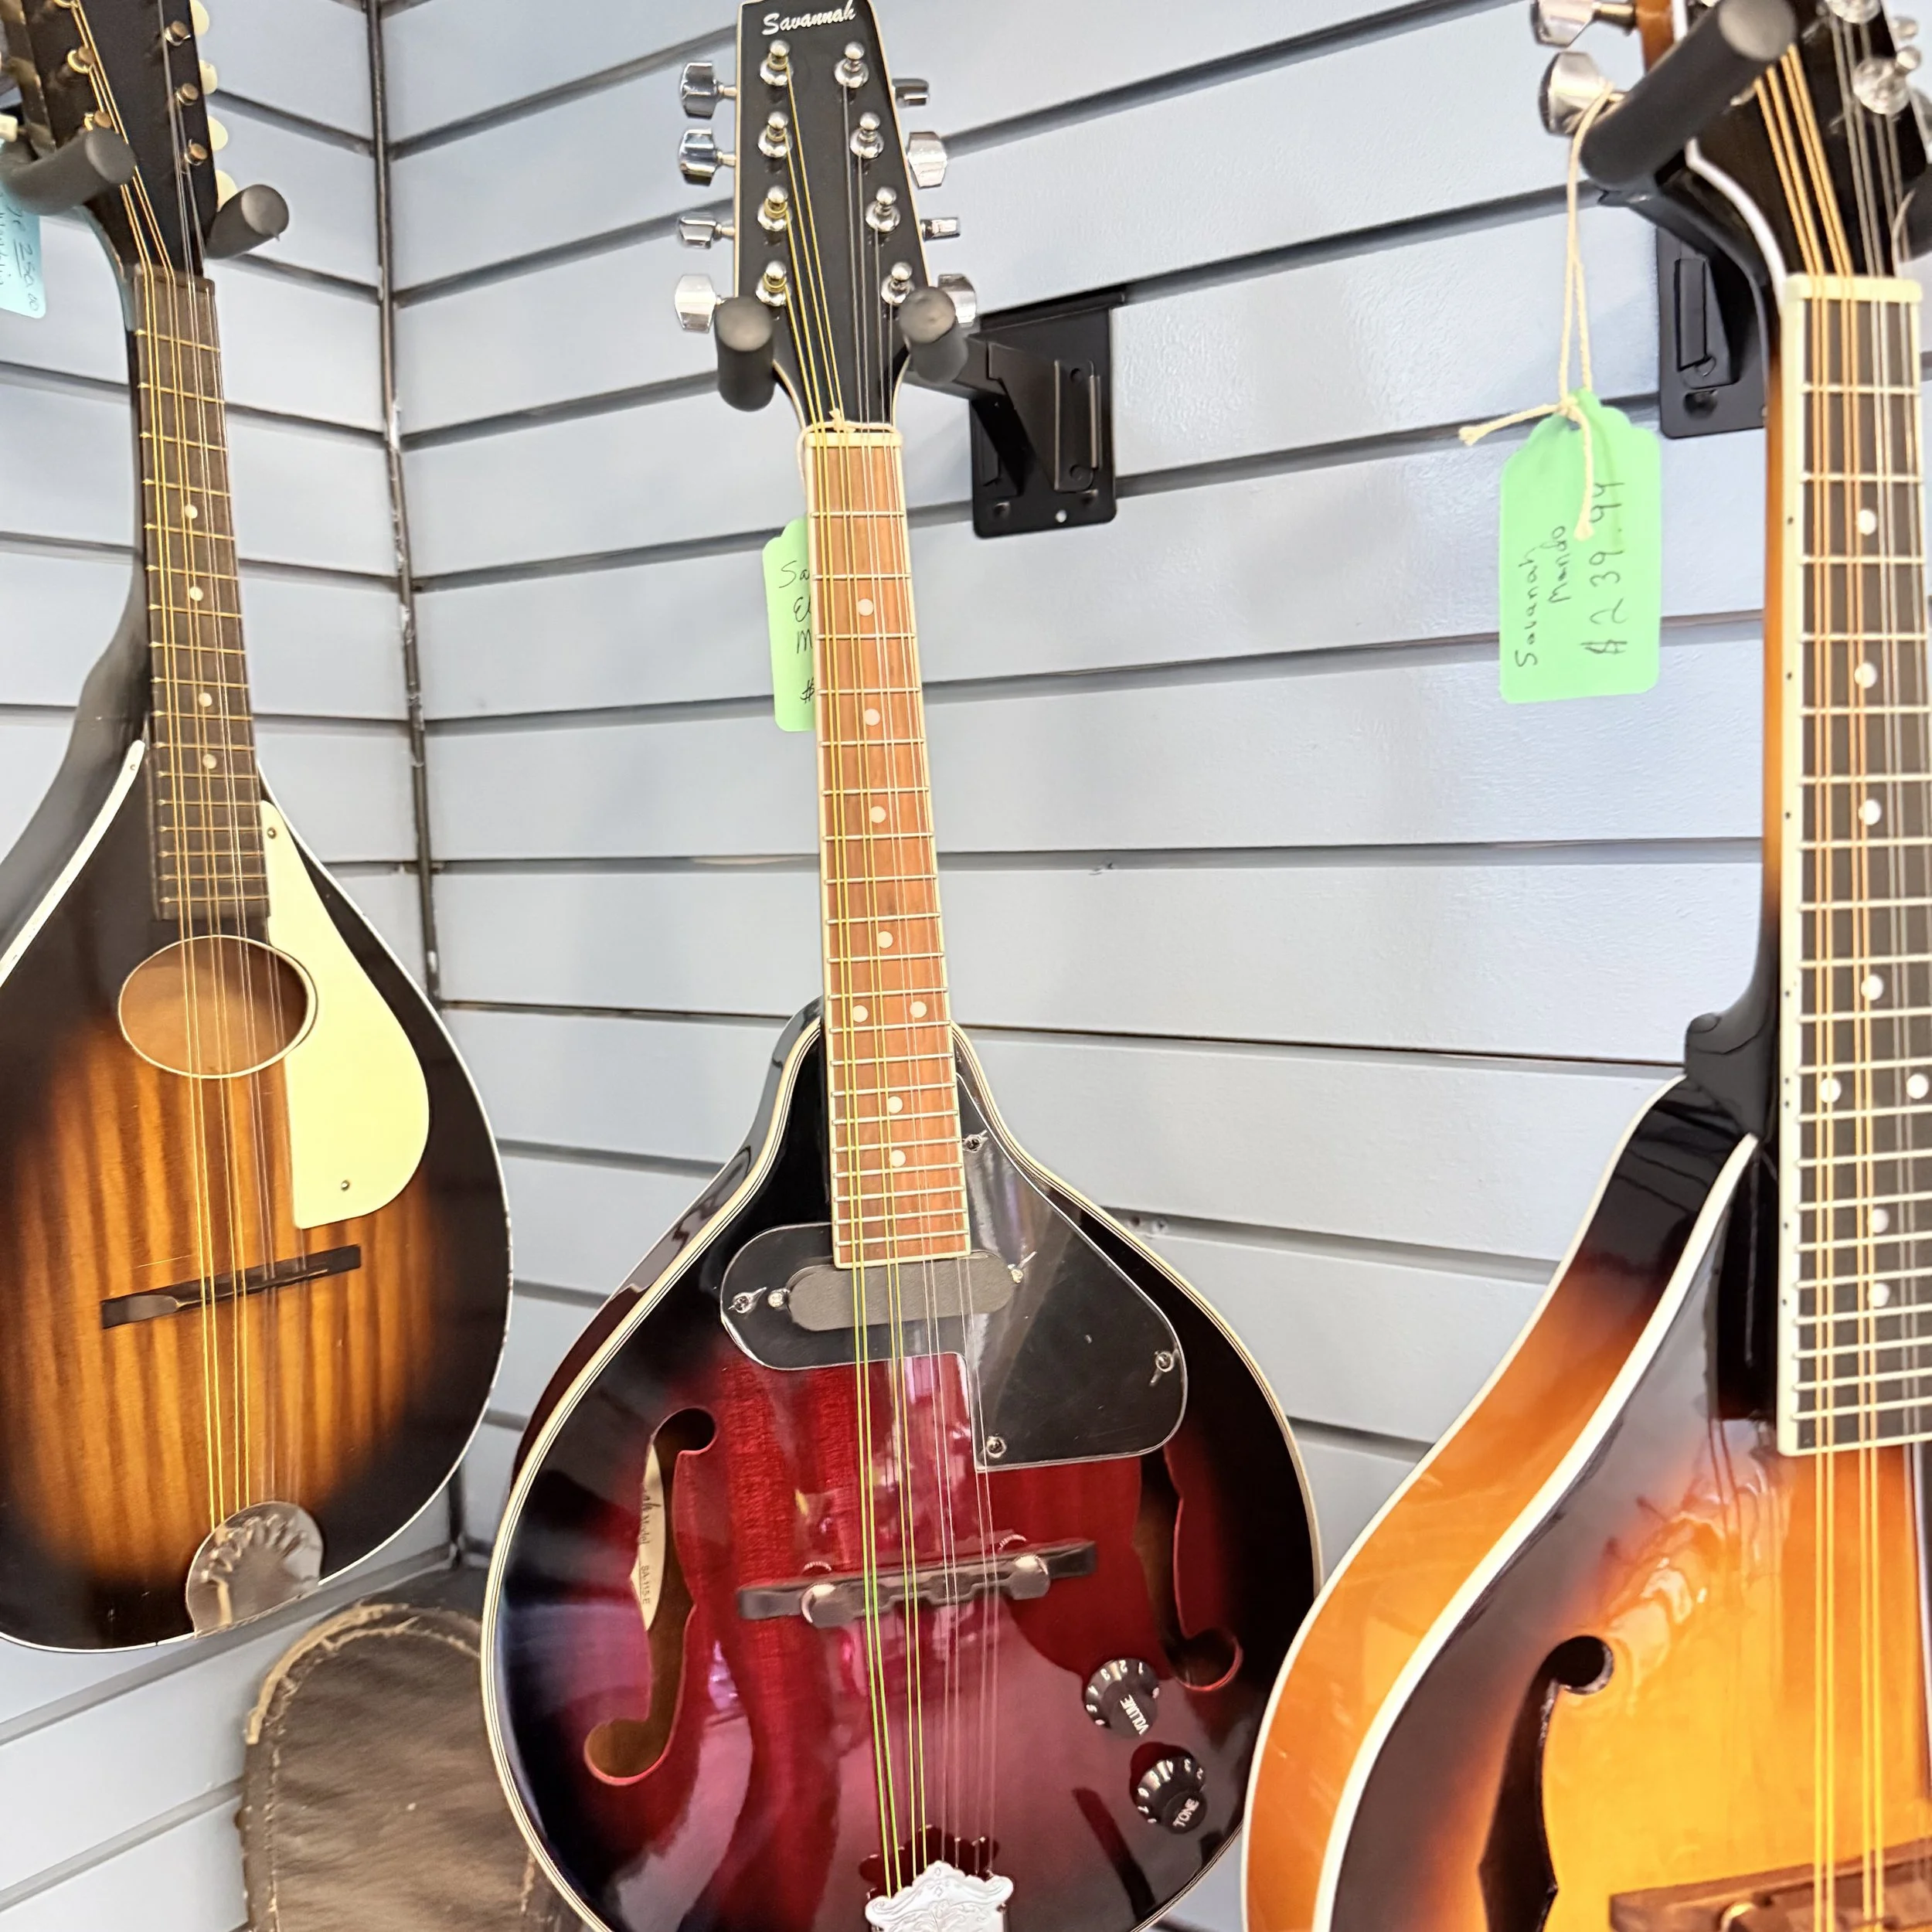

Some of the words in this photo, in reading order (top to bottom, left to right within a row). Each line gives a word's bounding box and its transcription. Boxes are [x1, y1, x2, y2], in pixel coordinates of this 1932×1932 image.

[761, 0, 856, 36] Savannah
[1121, 1694, 1149, 1736] VOLUME
[1172, 1798, 1199, 1828] TONE
